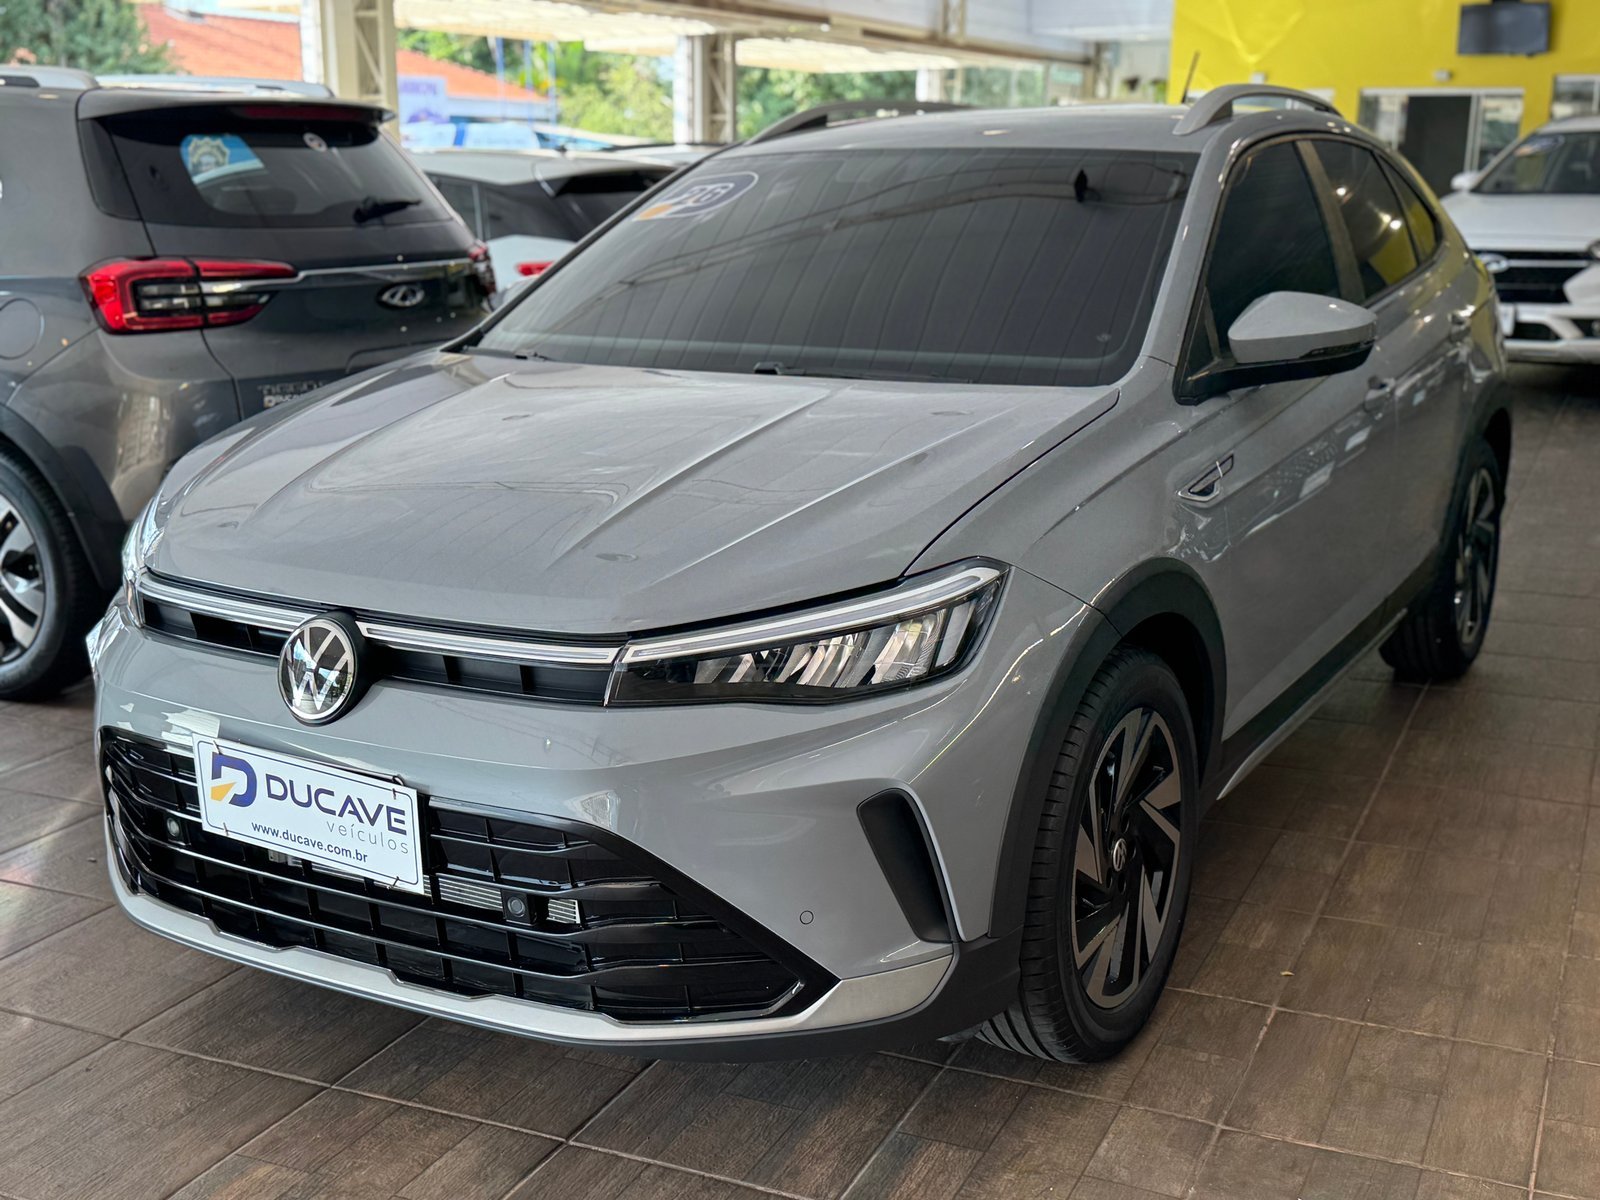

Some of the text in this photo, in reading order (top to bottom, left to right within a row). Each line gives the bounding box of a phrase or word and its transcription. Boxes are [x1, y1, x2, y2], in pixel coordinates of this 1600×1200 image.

[265, 773, 407, 836] DUCAVE
[251, 822, 368, 863] www.ducave.com.br
[326, 821, 409, 854] veículos
